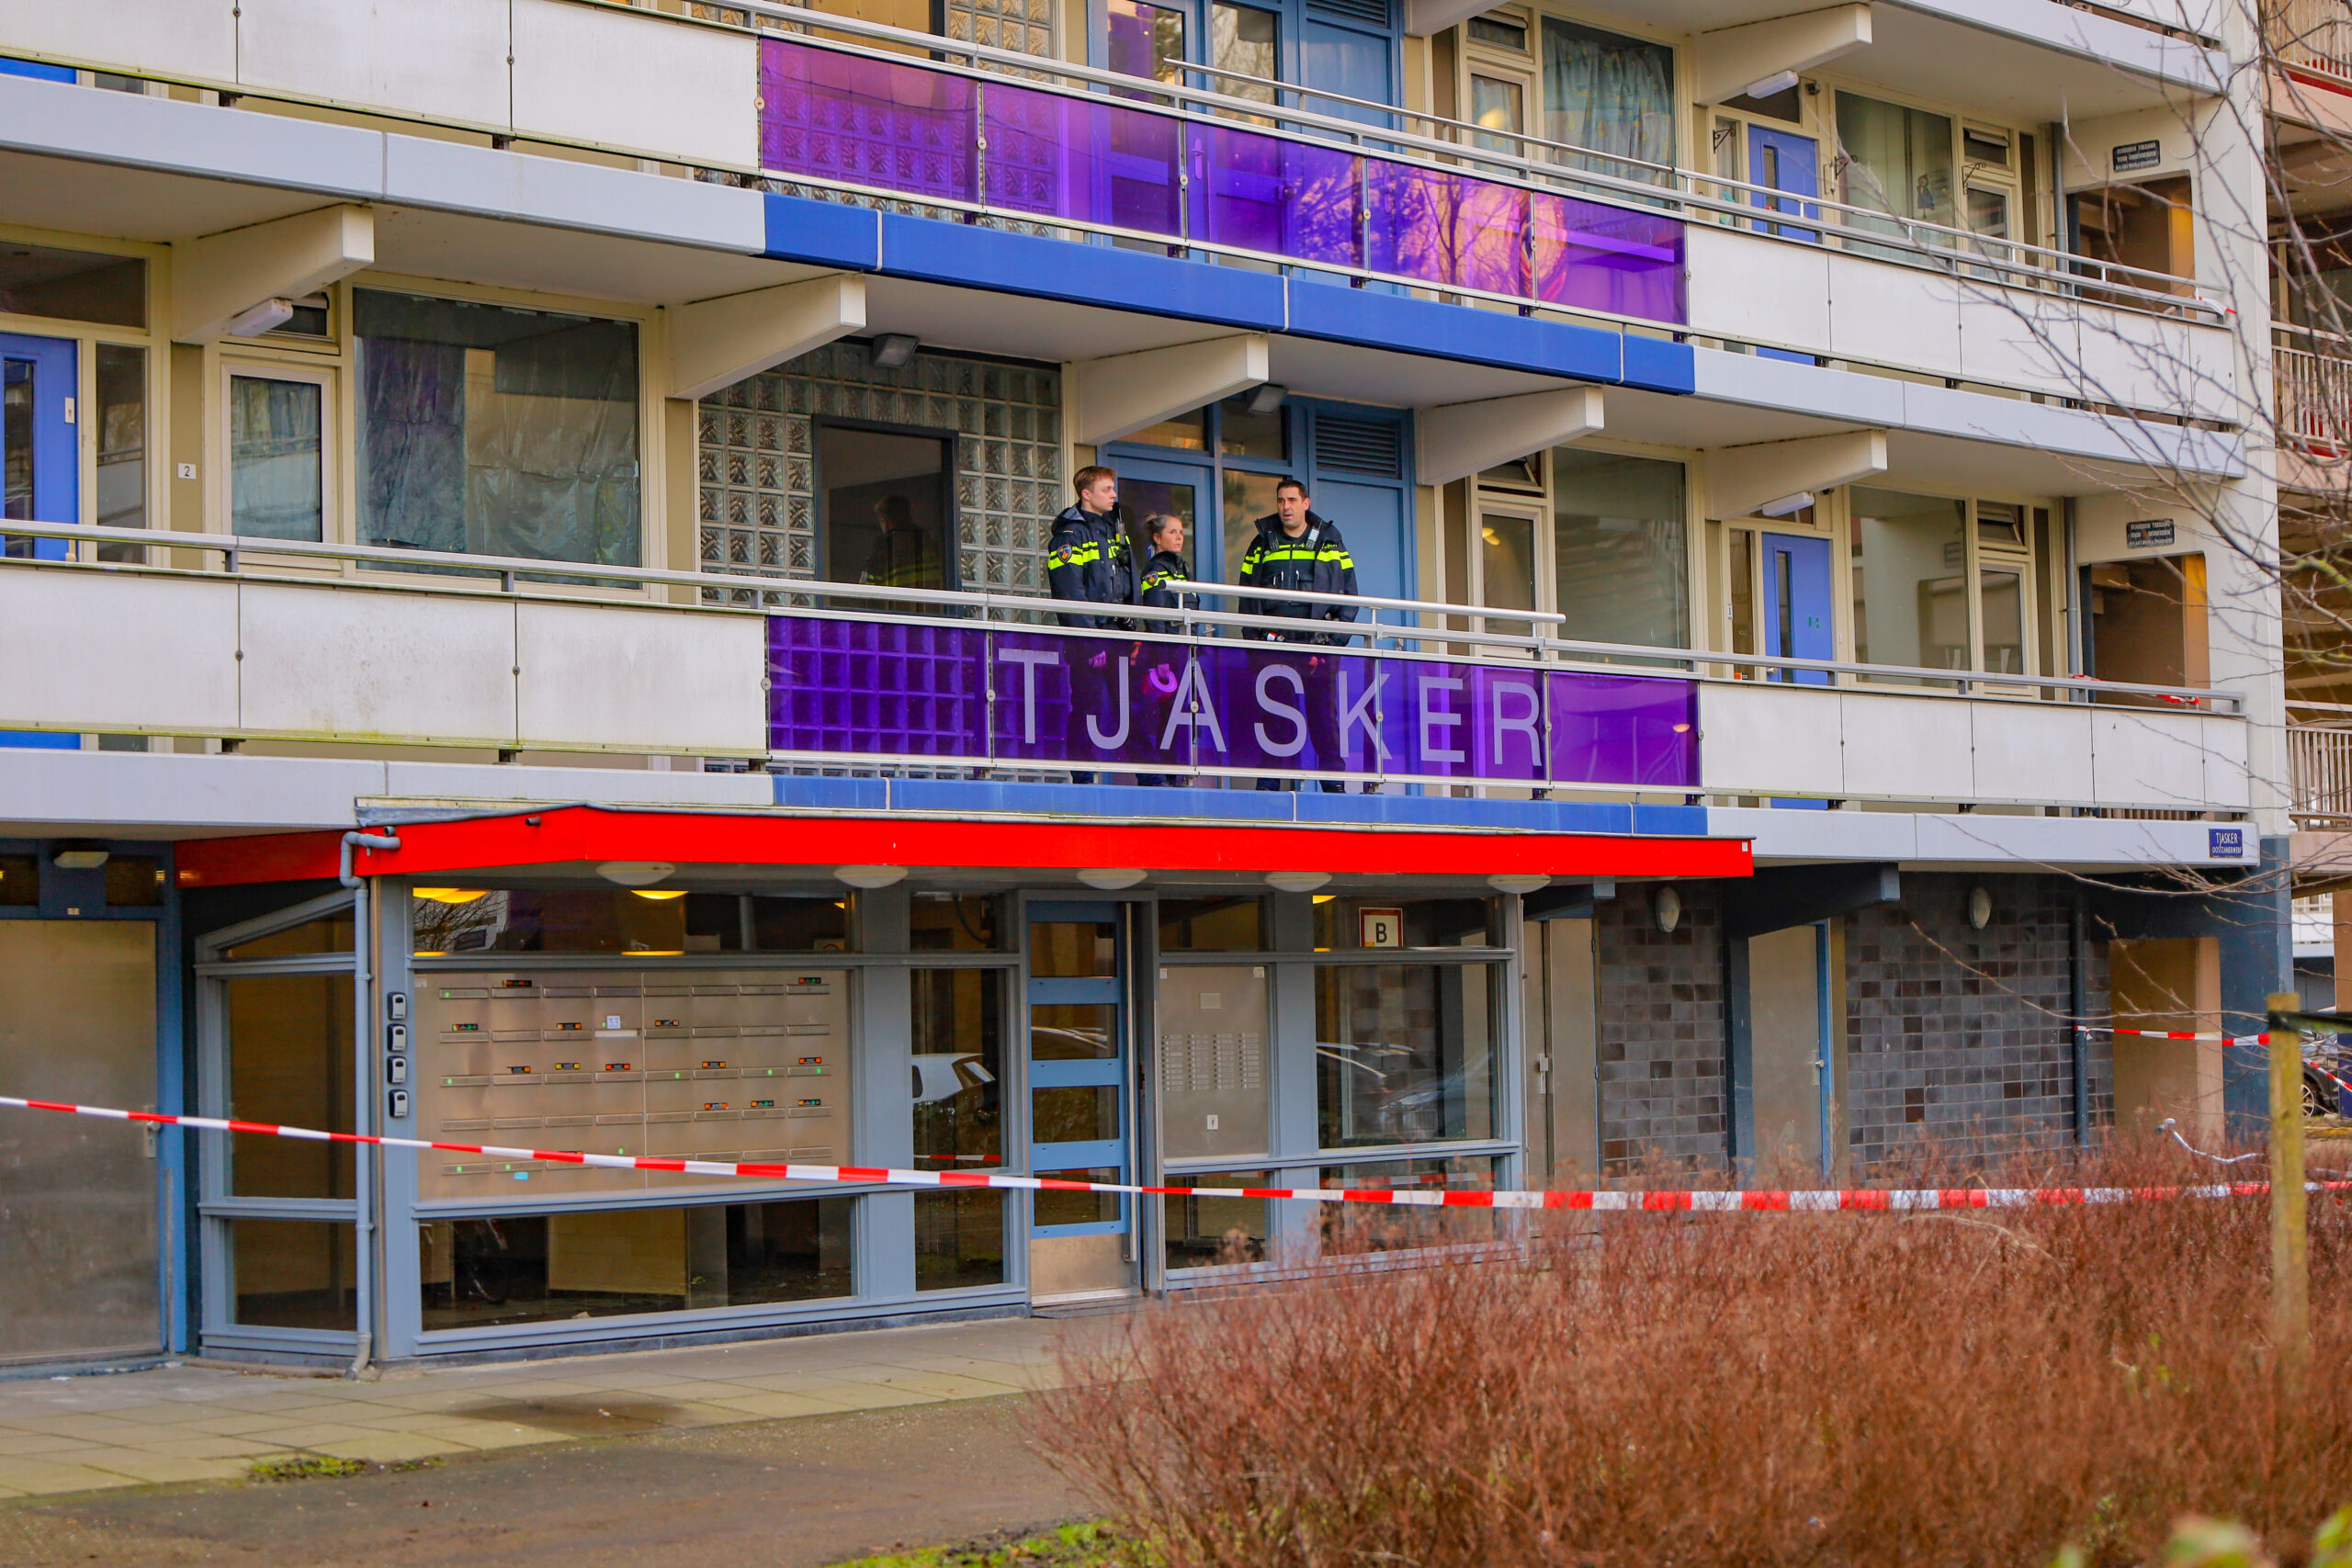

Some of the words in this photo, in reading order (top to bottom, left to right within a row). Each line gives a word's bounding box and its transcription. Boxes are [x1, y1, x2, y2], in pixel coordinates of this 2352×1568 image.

[184, 465, 190, 477] 2
[998, 647, 1543, 767] TJASKER
[2215, 832, 2239, 846] TJASKER
[1375, 921, 1387, 943] B
